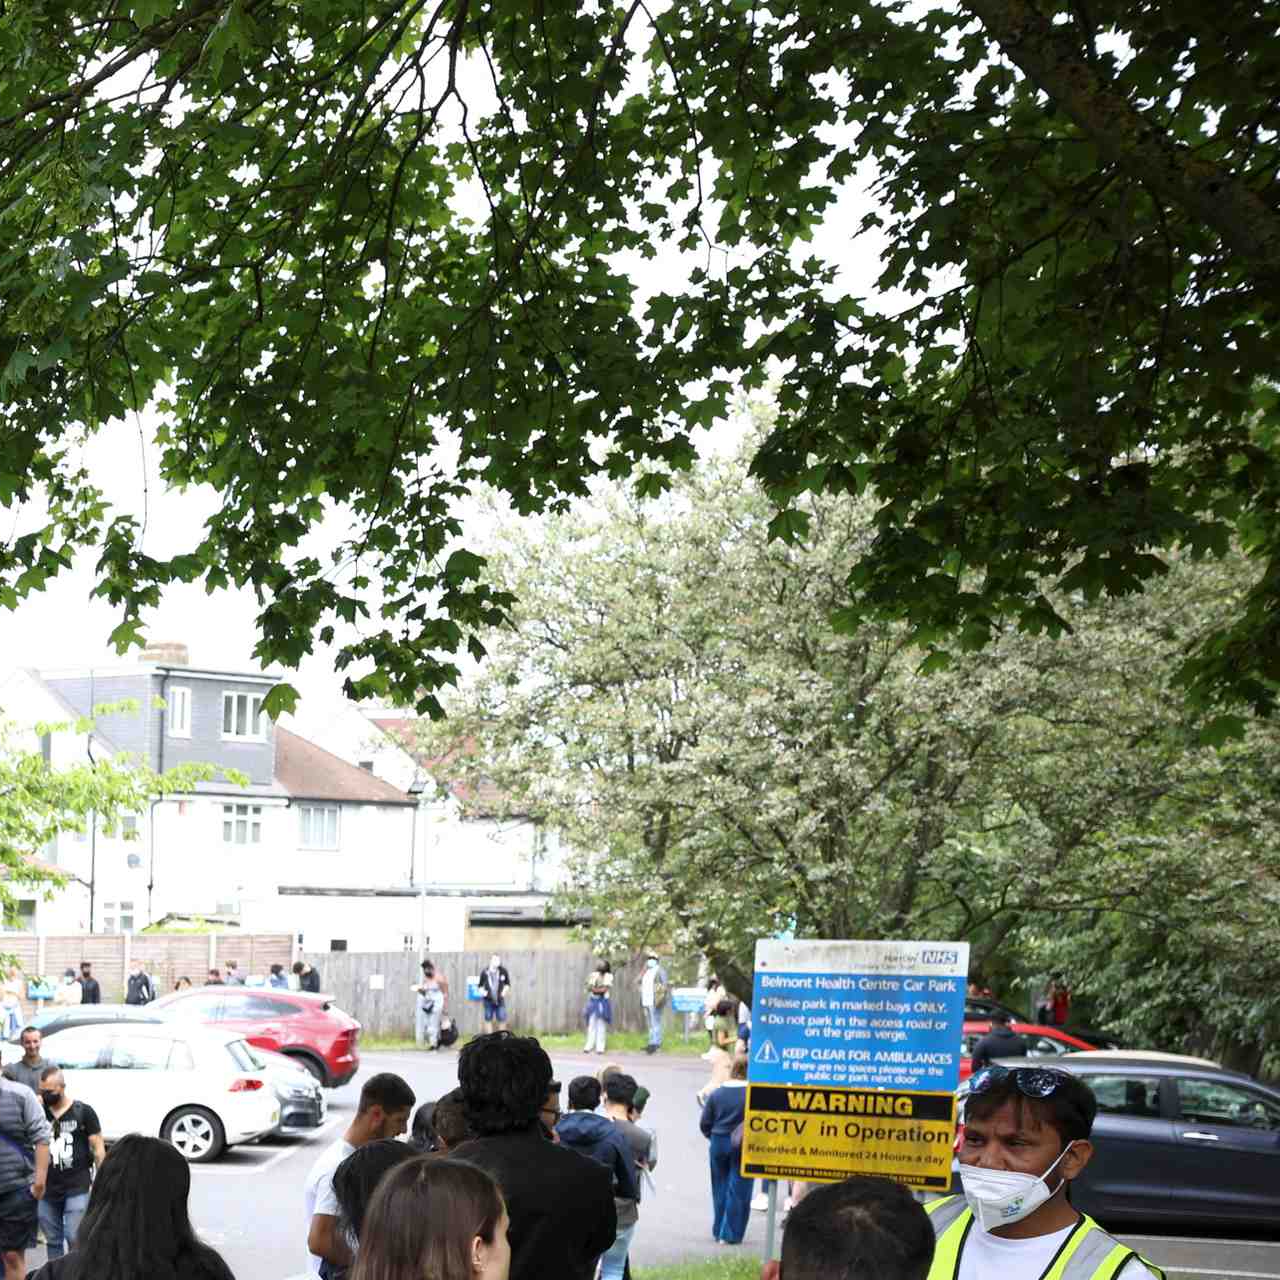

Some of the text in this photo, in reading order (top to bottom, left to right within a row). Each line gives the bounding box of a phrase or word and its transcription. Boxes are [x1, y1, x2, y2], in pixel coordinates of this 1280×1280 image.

[923, 951, 958, 964] NHS
[761, 976, 957, 992] Belmont Health Centre Car Park
[768, 998, 800, 1009] Please
[802, 999, 827, 1012] park
[830, 1000, 840, 1010] in
[842, 1000, 884, 1011] marked
[886, 1001, 911, 1014] bays
[769, 1014, 948, 1030] Do not park in the access road or
[804, 1026, 908, 1041] on the grass verge.
[782, 1048, 953, 1065] KEEP CLEAR FOR AMBULANCES
[792, 1061, 815, 1072] there
[817, 1063, 832, 1072] are
[834, 1064, 846, 1073] no
[848, 1064, 877, 1076] spaces
[879, 1064, 907, 1076] please
[909, 1067, 926, 1076] use
[928, 1066, 944, 1076] the
[804, 1071, 831, 1083] public
[833, 1073, 846, 1082] car
[848, 1073, 870, 1085] park
[871, 1074, 892, 1083] next
[787, 1091, 913, 1116] WARNING
[750, 1116, 950, 1144] CCTV in Operation
[748, 1143, 798, 1156] Recorded
[799, 1146, 808, 1156] &
[809, 1147, 863, 1160] Monitored
[865, 1150, 878, 1161] 24
[880, 1151, 912, 1163] Hours
[925, 1154, 946, 1167] day
